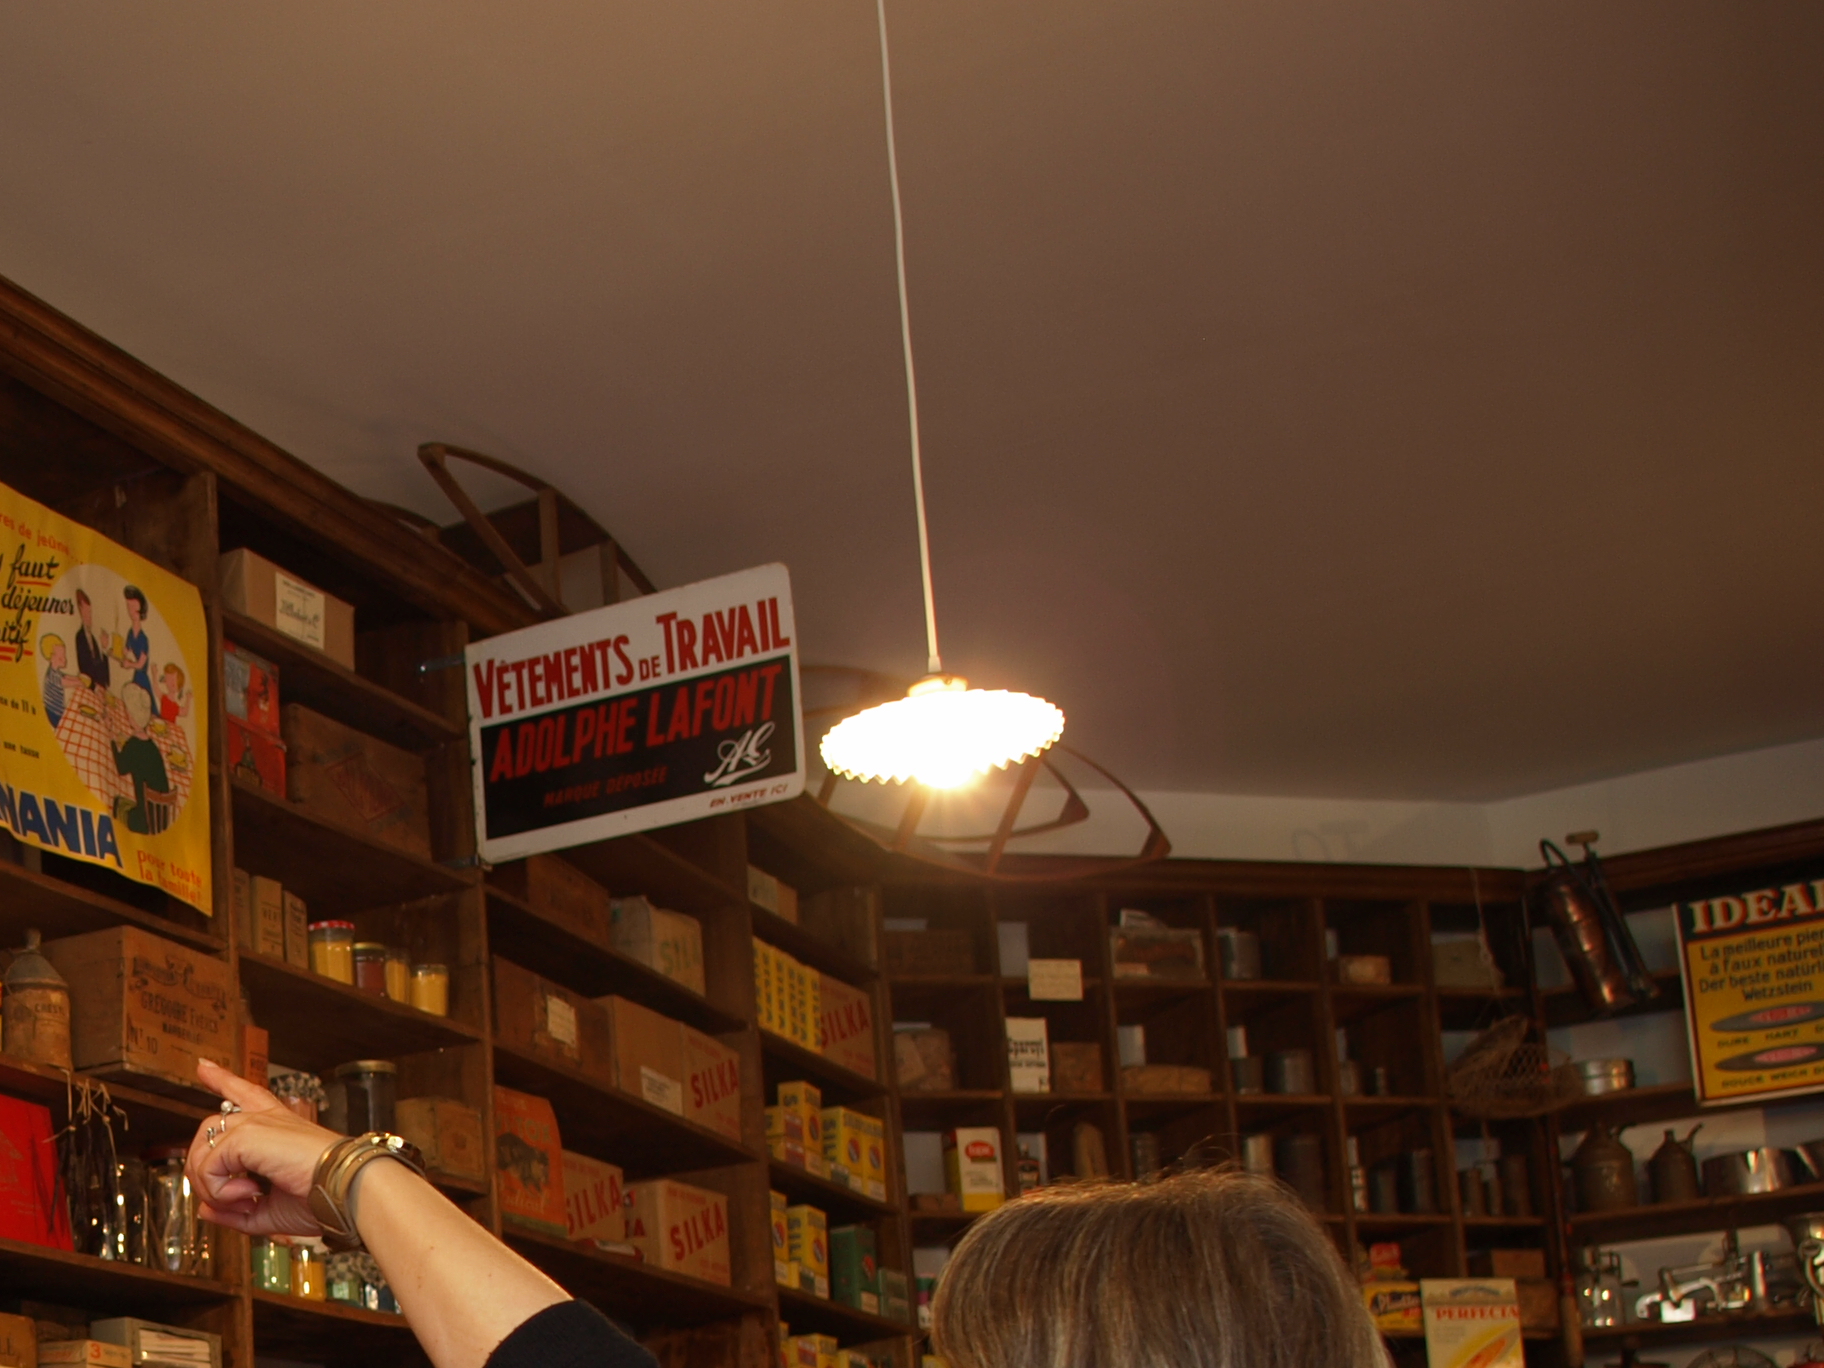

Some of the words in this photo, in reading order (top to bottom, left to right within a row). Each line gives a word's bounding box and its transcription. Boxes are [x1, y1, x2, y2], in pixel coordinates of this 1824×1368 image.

[18, 522, 32, 541] de
[8, 544, 60, 589] faut
[1, 585, 75, 621] déjeuner
[474, 634, 635, 720] VÊTEMENTS
[639, 655, 661, 682] DE
[656, 597, 790, 675] TRAVAIL
[490, 698, 637, 783] ADOLPHE
[645, 664, 782, 748] LAFONT
[543, 780, 600, 809] MARQUE
[730, 788, 767, 805] VENTE
[137, 850, 166, 872] pour
[170, 862, 202, 887] toute
[139, 867, 153, 882] la
[1701, 945, 1720, 960] La
[1723, 934, 1792, 957] meilleure
[1699, 977, 1725, 992] Der
[1730, 971, 1770, 988] beste
[1743, 980, 1813, 1001] Wetzstein
[820, 1001, 869, 1049] SILKA
[691, 1059, 738, 1109] SILKA
[670, 1202, 725, 1262] SILKA
[90, 1343, 101, 1359] 3
